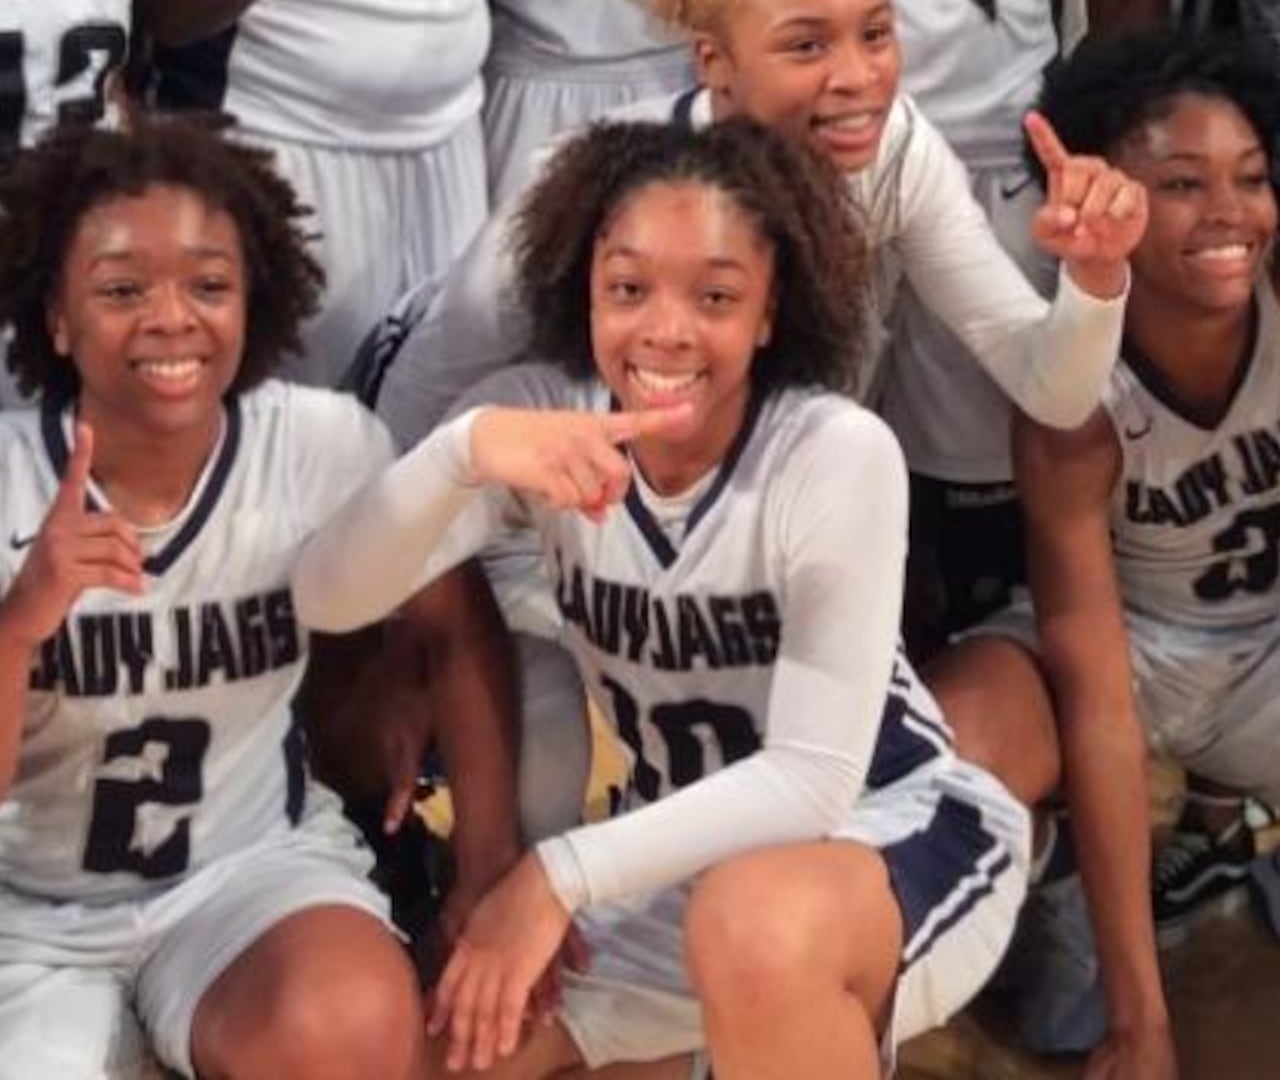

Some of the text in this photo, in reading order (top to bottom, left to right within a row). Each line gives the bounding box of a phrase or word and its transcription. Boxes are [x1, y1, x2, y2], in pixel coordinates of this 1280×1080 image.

[1126, 453, 1230, 528] LADY
[28, 586, 300, 697] ADY JAGS
[650, 589, 783, 672] JAGS
[81, 716, 212, 879] 2
